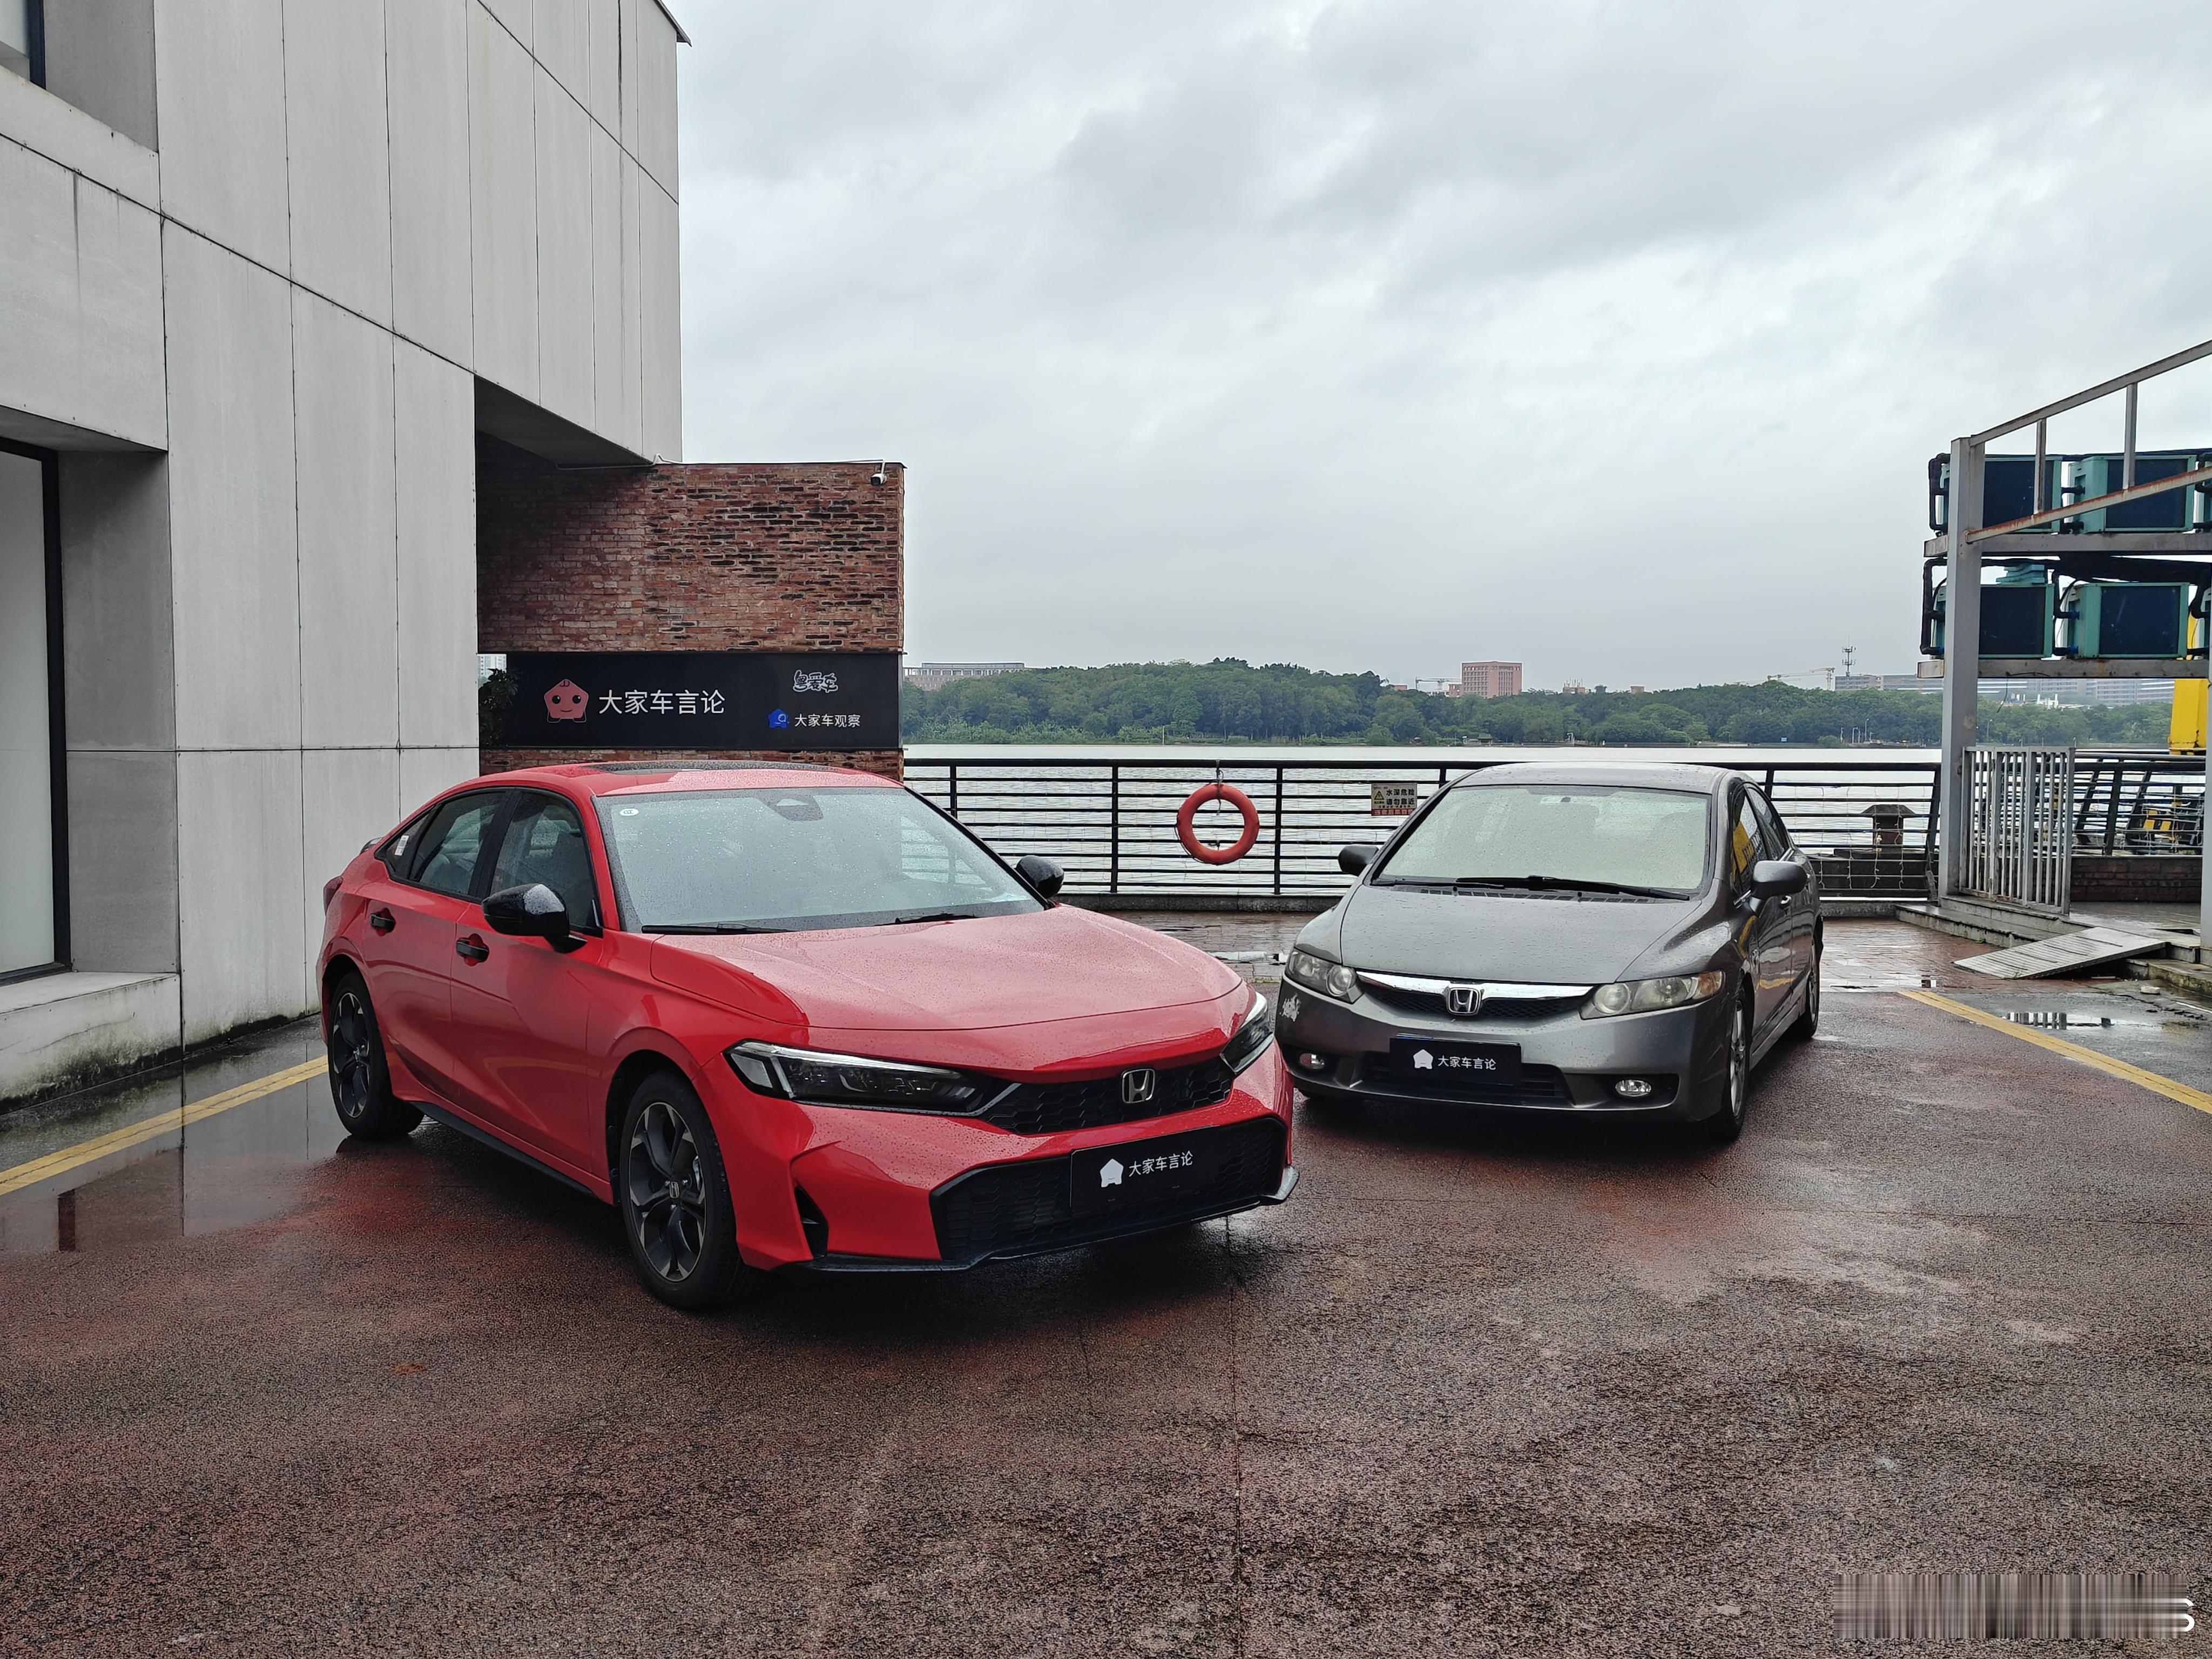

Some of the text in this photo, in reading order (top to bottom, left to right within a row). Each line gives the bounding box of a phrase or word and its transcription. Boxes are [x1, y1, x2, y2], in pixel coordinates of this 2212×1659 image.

[599, 689, 725, 714] 大家车言论
[794, 713, 861, 728] 大家车观察
[1438, 1055, 1496, 1070] 大家车言论
[1129, 1150, 1193, 1177] 大家车言论
